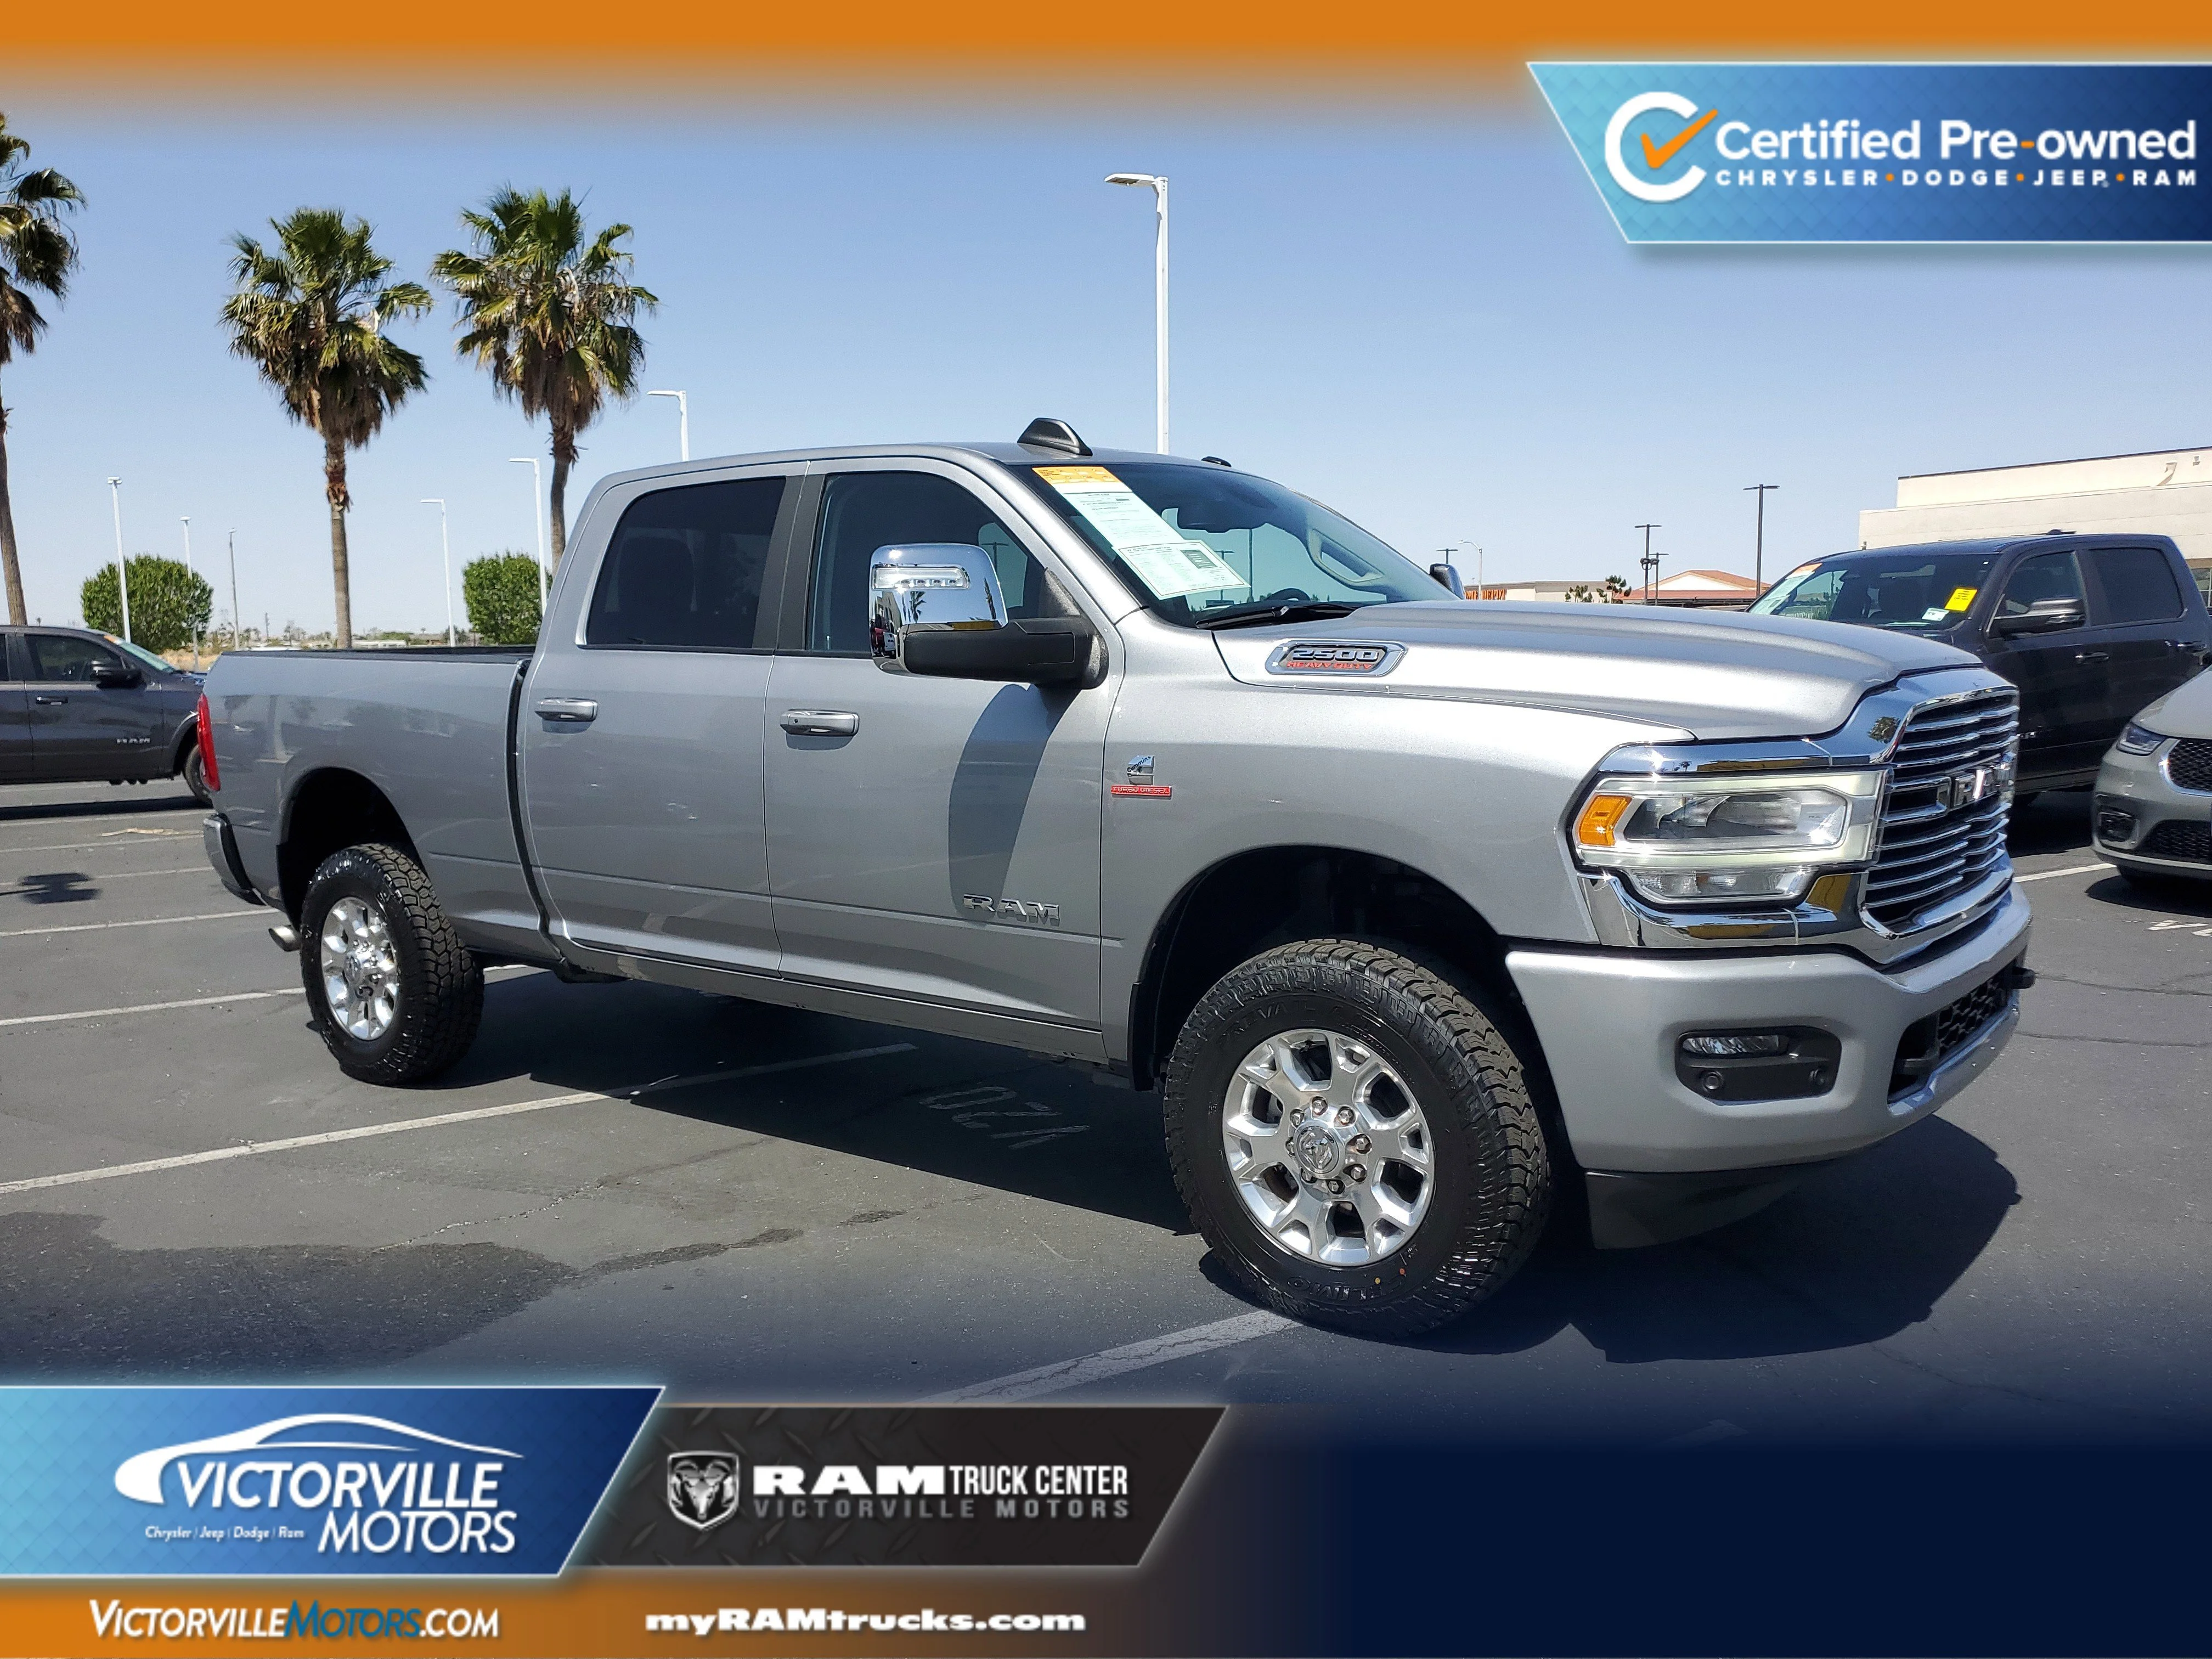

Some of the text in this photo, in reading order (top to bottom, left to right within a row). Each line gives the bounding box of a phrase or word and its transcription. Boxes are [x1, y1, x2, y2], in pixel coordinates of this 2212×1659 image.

[1292, 648, 1379, 663] 2500
[1333, 662, 1373, 670] DUTY
[1126, 755, 1152, 773] Cummins
[963, 893, 1060, 922] RAM
